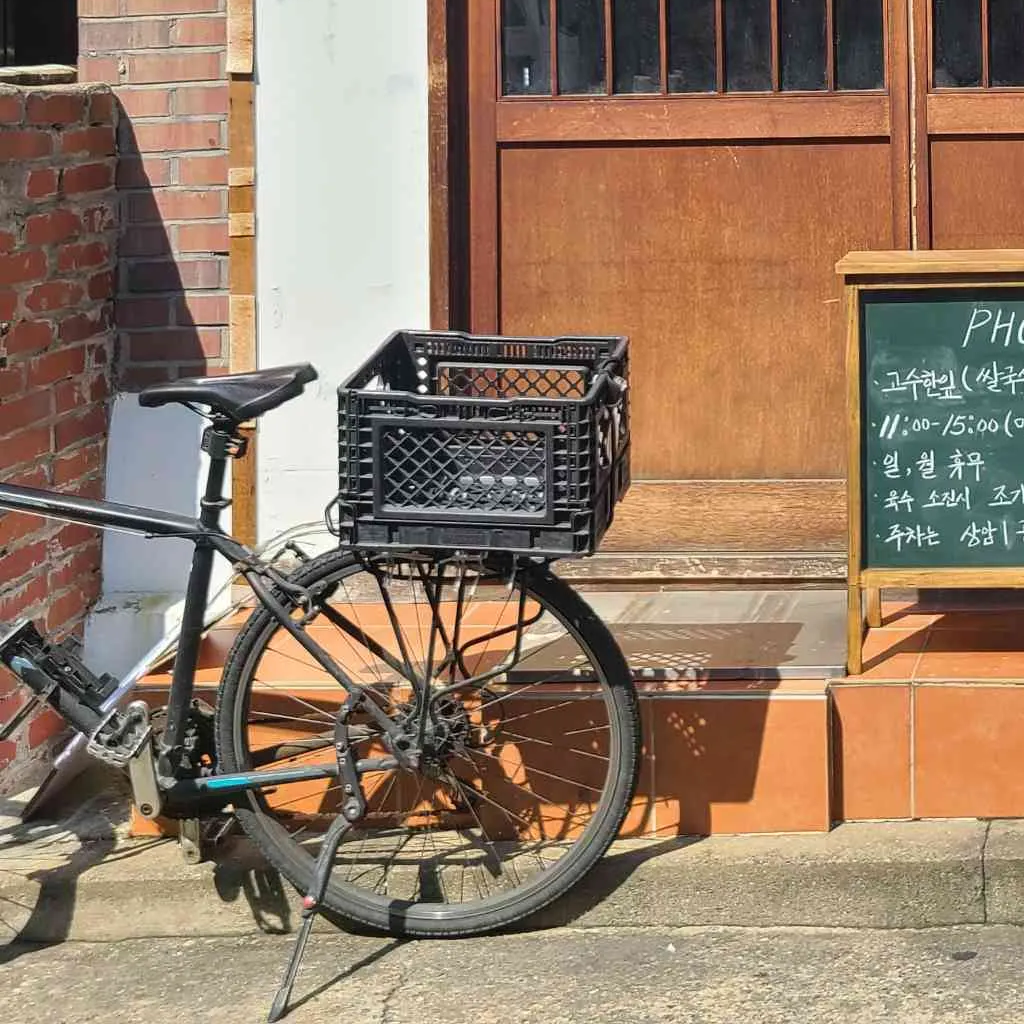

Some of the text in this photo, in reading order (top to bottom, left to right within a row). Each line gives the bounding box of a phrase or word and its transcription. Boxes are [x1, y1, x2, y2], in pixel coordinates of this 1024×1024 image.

[948, 448, 985, 482] 휴무
[883, 489, 915, 513] 육수
[883, 524, 941, 552] 주차는
